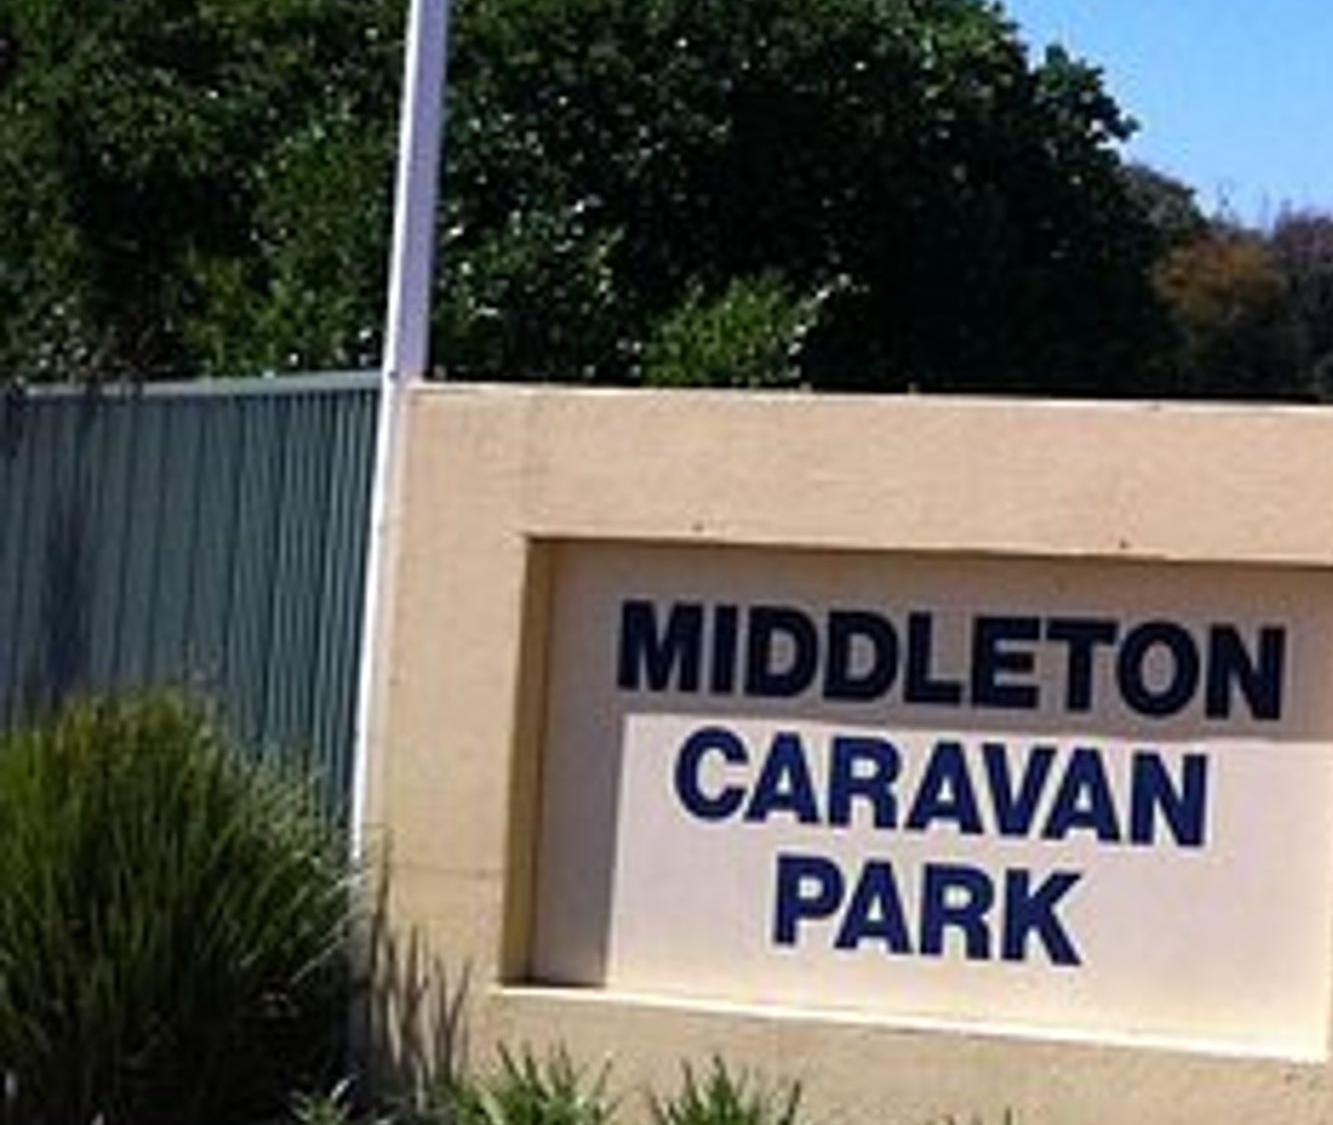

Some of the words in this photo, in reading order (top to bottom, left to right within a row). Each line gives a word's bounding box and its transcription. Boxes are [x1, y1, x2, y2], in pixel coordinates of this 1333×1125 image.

[616, 600, 1286, 721] MIDDLETON
[674, 725, 1208, 847] CARAVAN
[771, 854, 1084, 966] PARK
